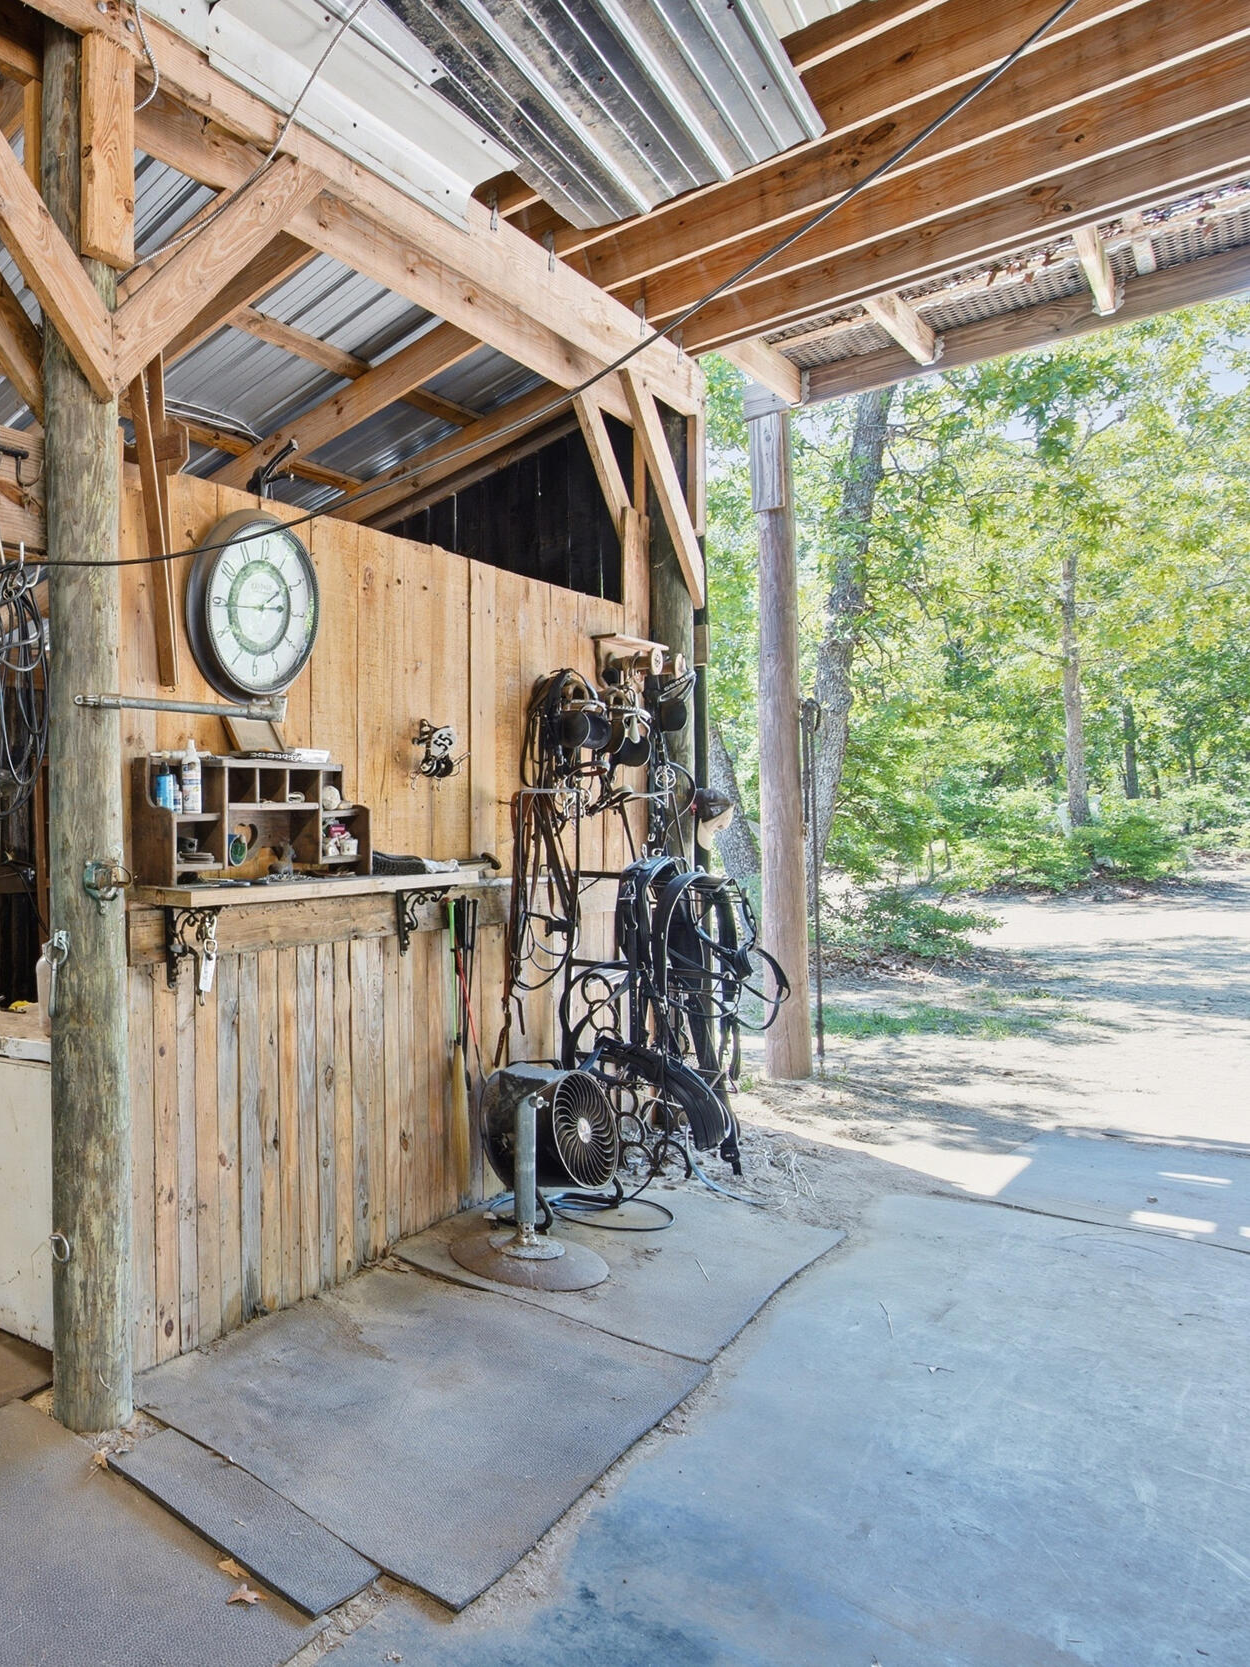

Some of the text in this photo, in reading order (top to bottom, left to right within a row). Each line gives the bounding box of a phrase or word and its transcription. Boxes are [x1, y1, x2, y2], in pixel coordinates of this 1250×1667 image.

[240, 542, 251, 563] 11
[221, 560, 236, 582] 10
[288, 578, 302, 592] 2
[212, 596, 228, 607] 9
[290, 610, 305, 619] 3
[216, 625, 232, 638] 8
[252, 655, 258, 677] 6
[433, 733, 453, 752] 55
